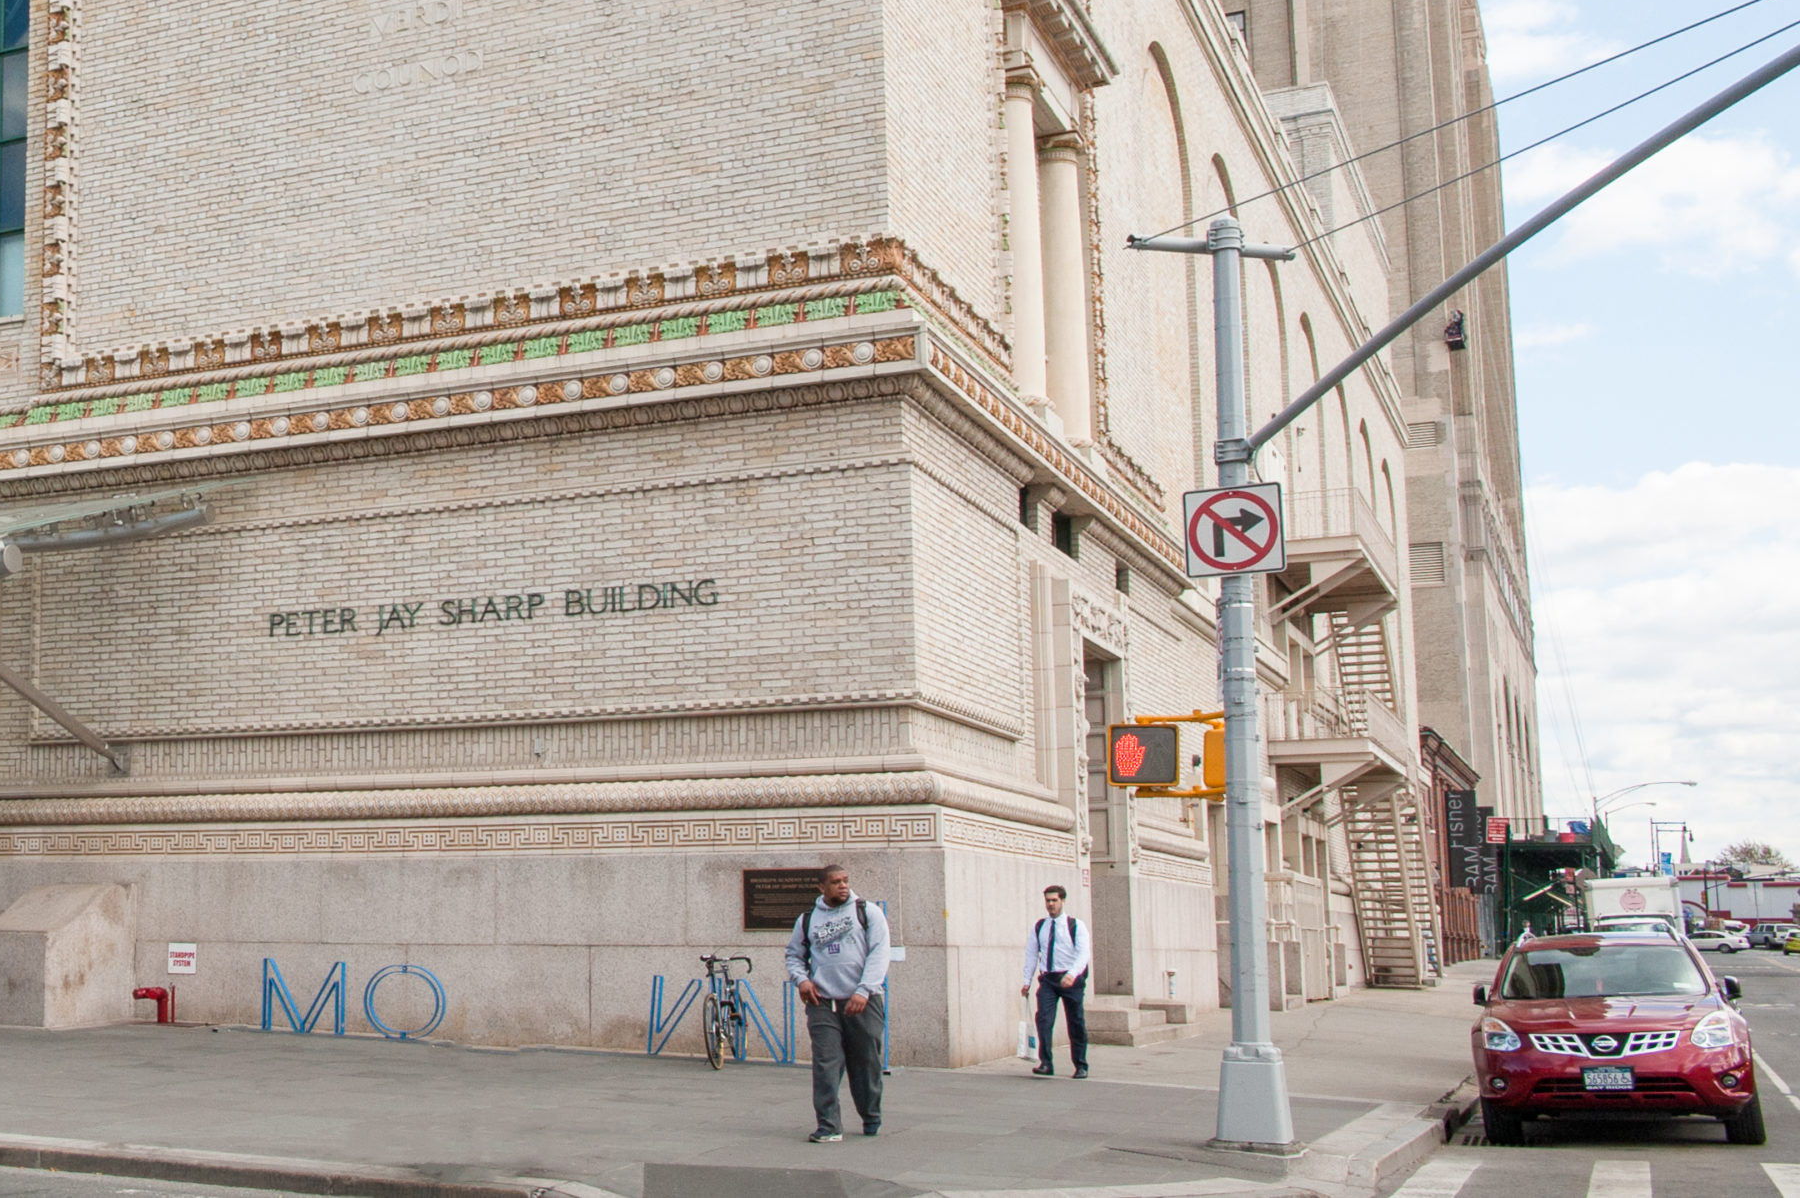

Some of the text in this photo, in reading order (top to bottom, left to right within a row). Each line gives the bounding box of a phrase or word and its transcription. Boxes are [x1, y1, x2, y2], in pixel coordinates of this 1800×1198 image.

[269, 577, 720, 637] PETER JAY SHARP BUILDING
